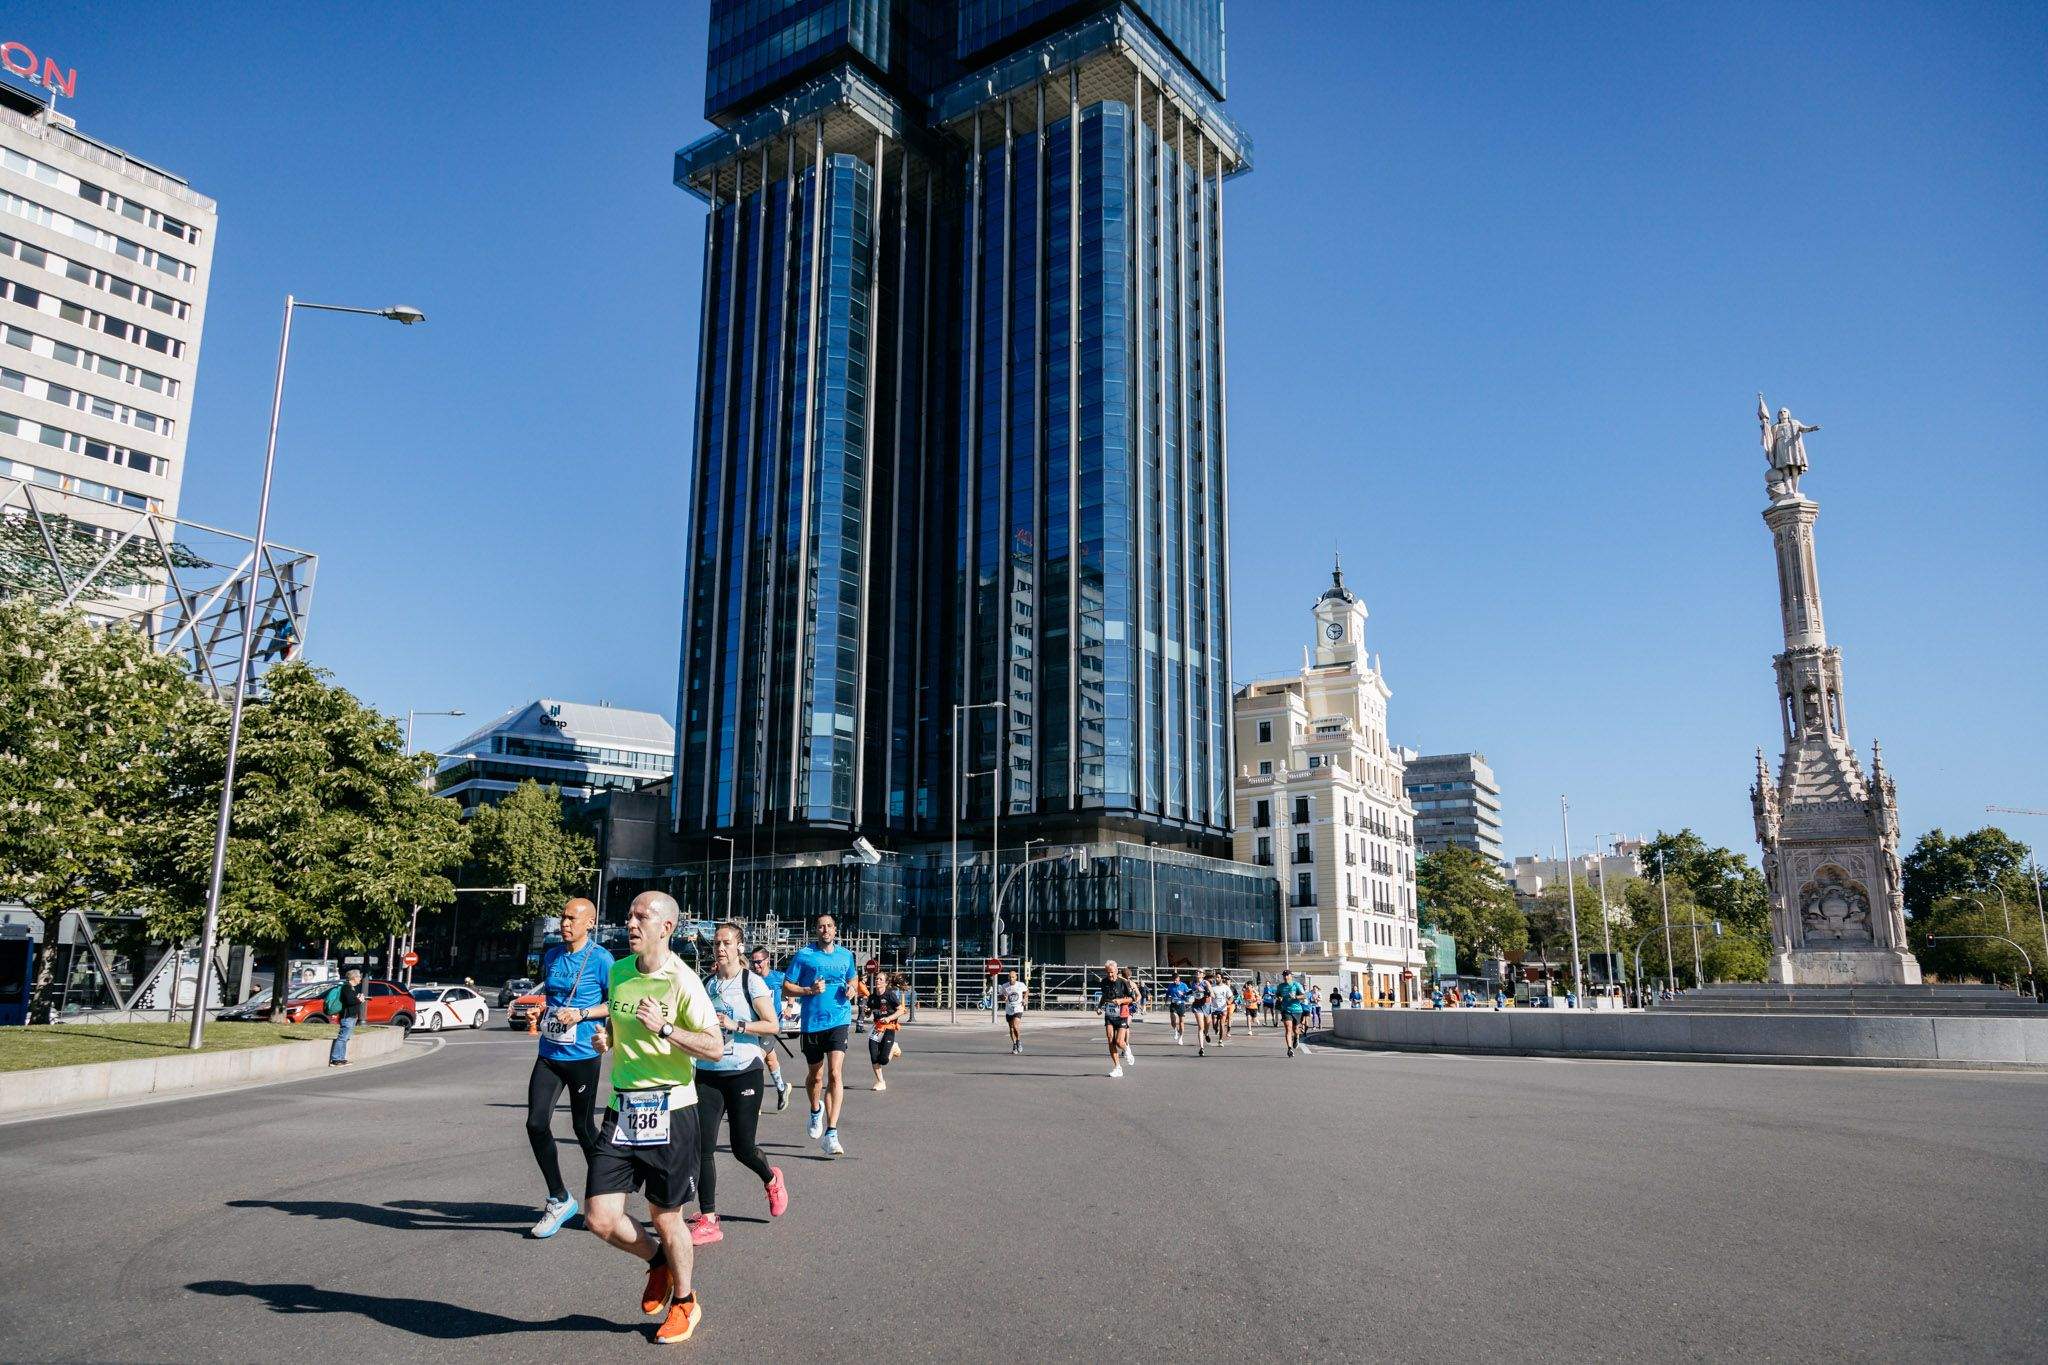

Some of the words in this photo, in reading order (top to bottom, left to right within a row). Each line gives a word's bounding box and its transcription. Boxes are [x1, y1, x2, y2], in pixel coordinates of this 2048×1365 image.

[0, 41, 77, 98] ON
[547, 1022, 568, 1034] 1234
[627, 1113, 658, 1130] 1236
